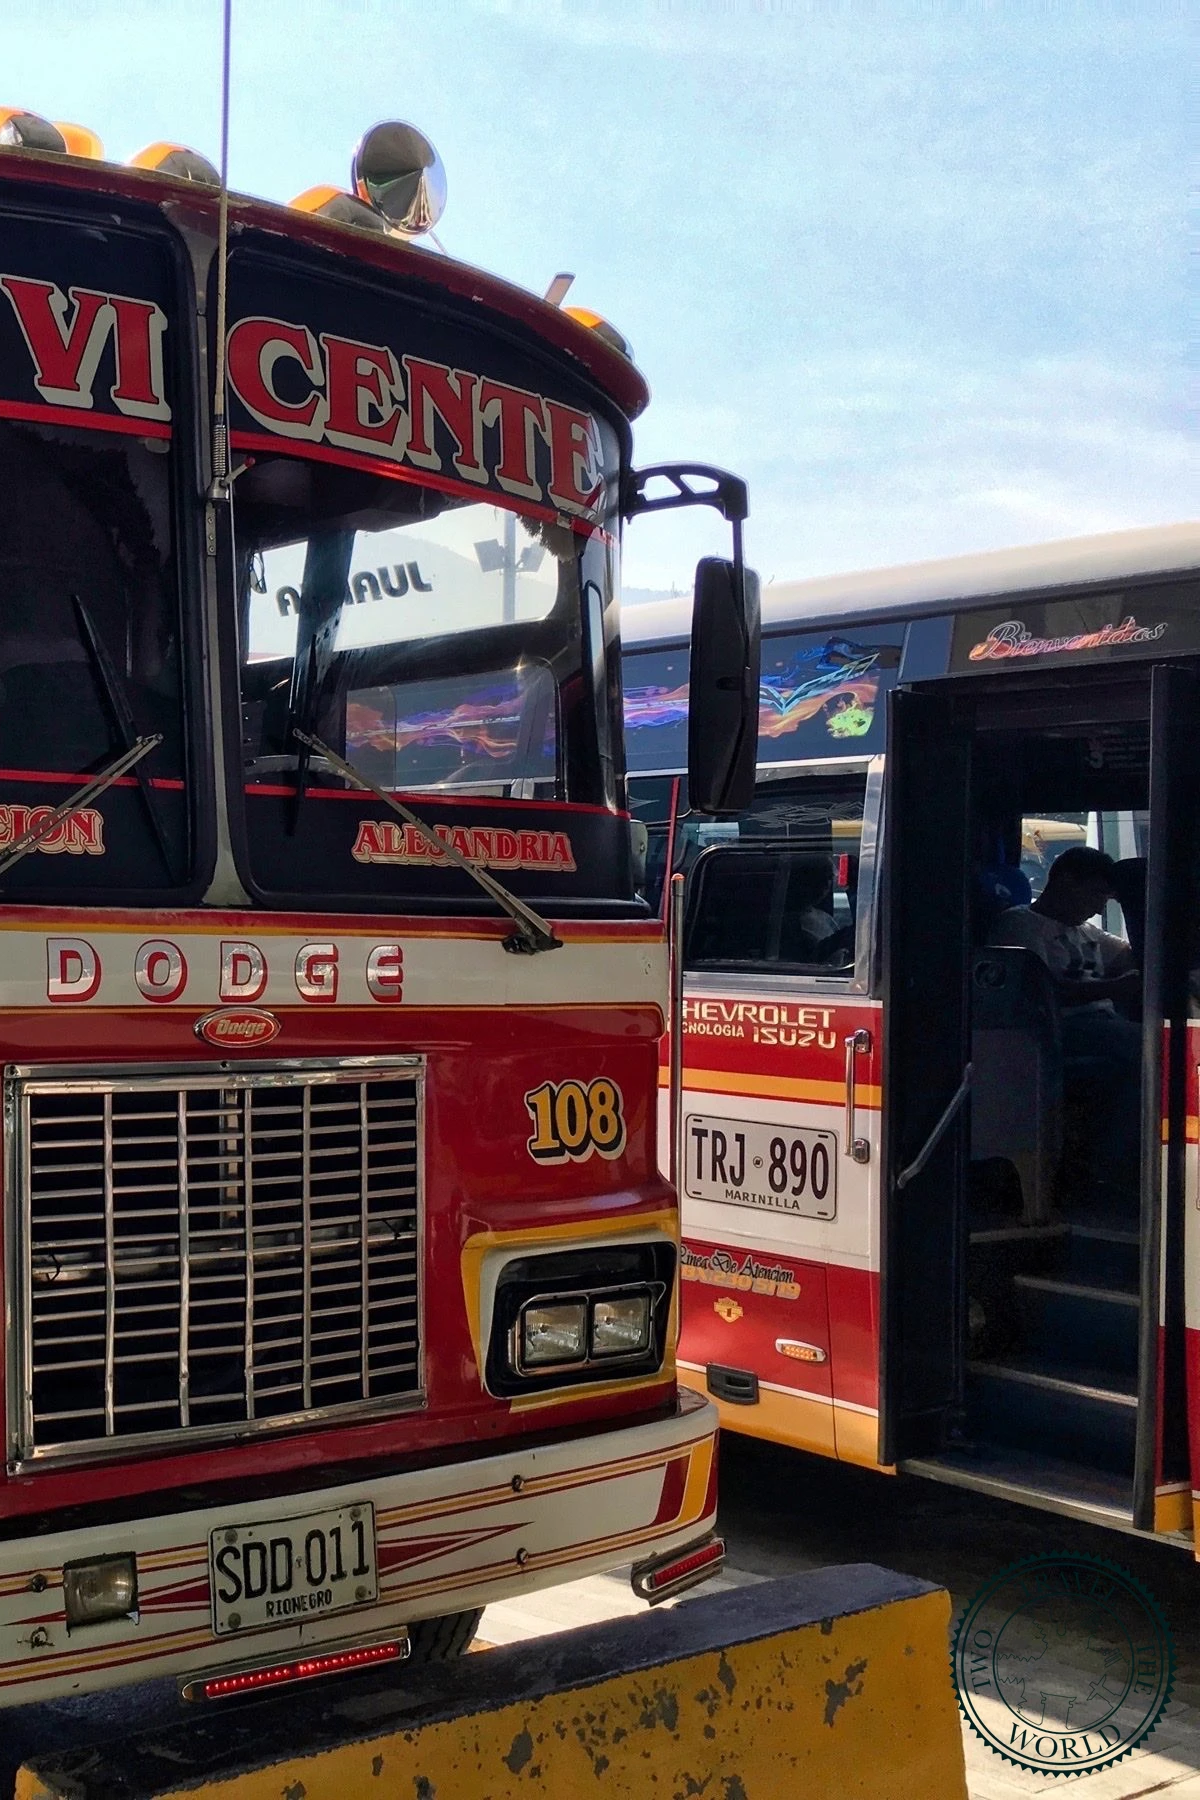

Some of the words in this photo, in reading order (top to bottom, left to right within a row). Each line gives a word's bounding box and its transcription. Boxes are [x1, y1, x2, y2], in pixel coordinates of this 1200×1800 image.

[968, 616, 1168, 660] Bienvenidos
[46, 938, 404, 1003] DODGE
[216, 1018, 267, 1036] Dodge
[667, 1001, 836, 1029] HEVROLET
[753, 1026, 836, 1049] ISUZU
[524, 1076, 627, 1165] 108
[692, 1127, 745, 1187] TRJ
[768, 1137, 829, 1200] 890
[725, 1189, 800, 1210] MARINILLA
[216, 1537, 293, 1603] SDD
[305, 1521, 370, 1587] 011
[266, 1589, 333, 1618] RIONEGRO
